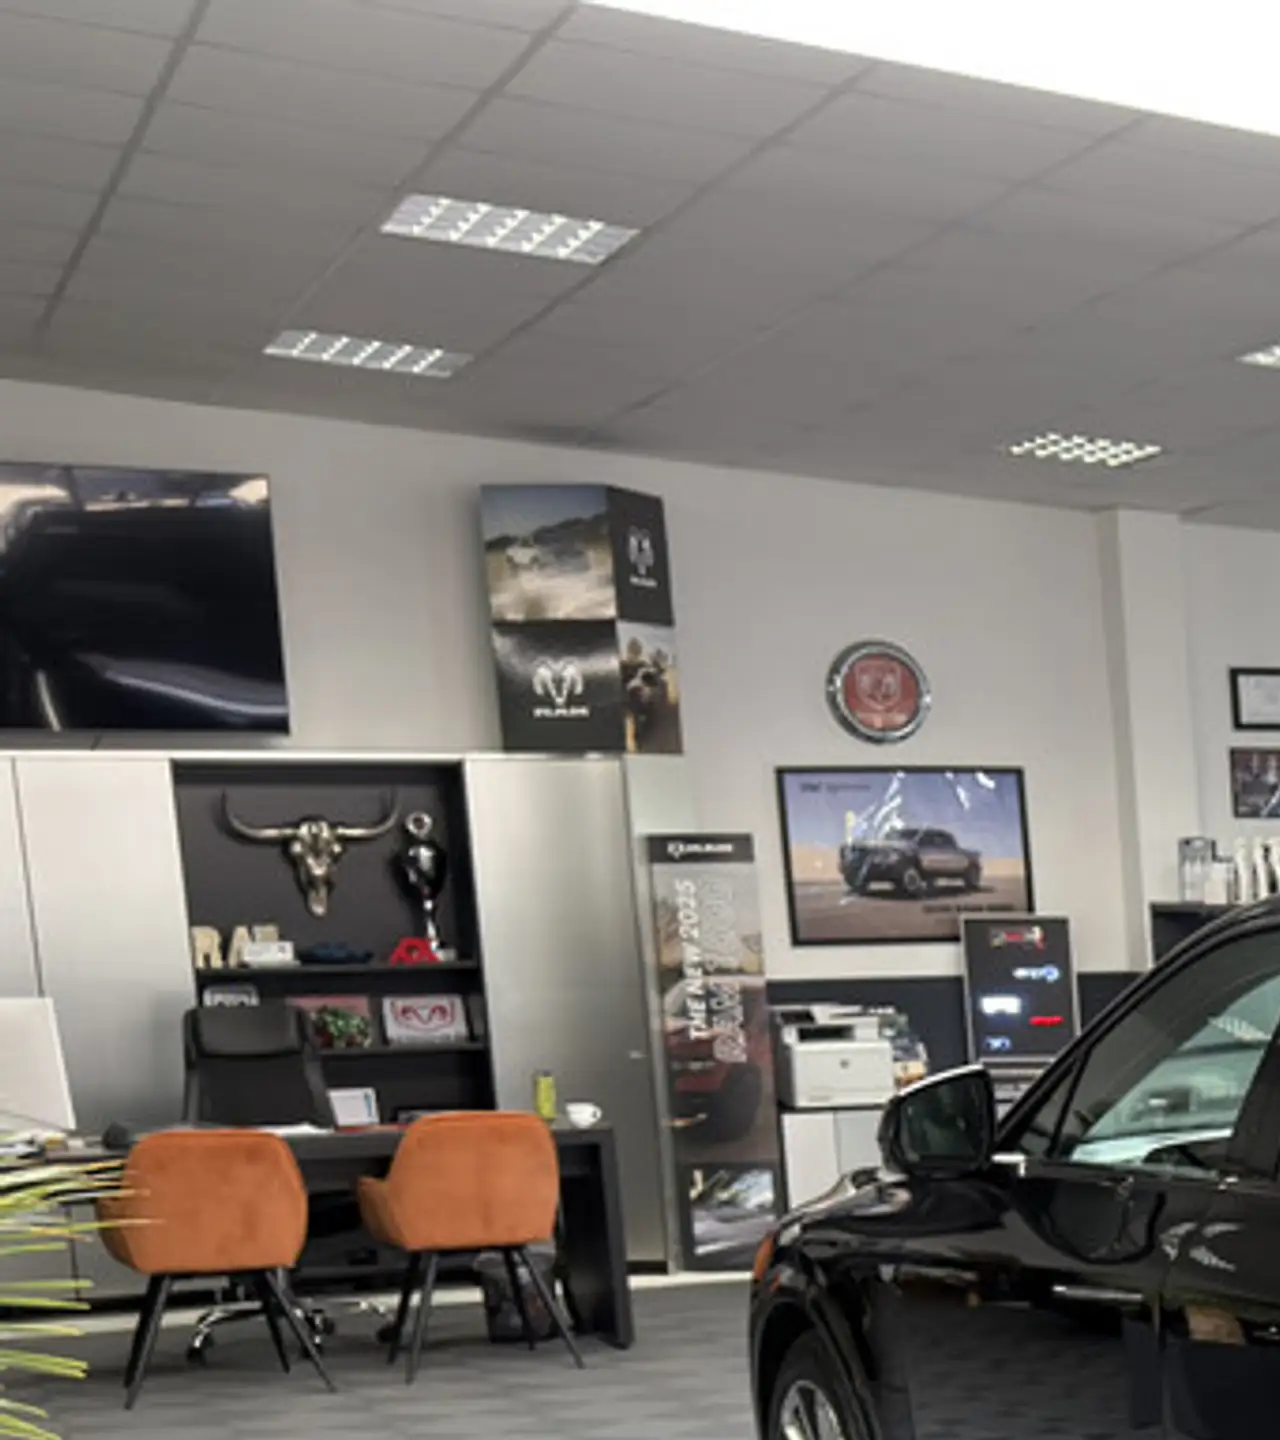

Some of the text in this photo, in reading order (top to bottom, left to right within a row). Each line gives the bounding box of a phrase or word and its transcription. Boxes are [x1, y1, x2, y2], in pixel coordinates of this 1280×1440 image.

[675, 878, 698, 939] 2025
[682, 945, 702, 995] NEW
[689, 1000, 707, 1040] THE
